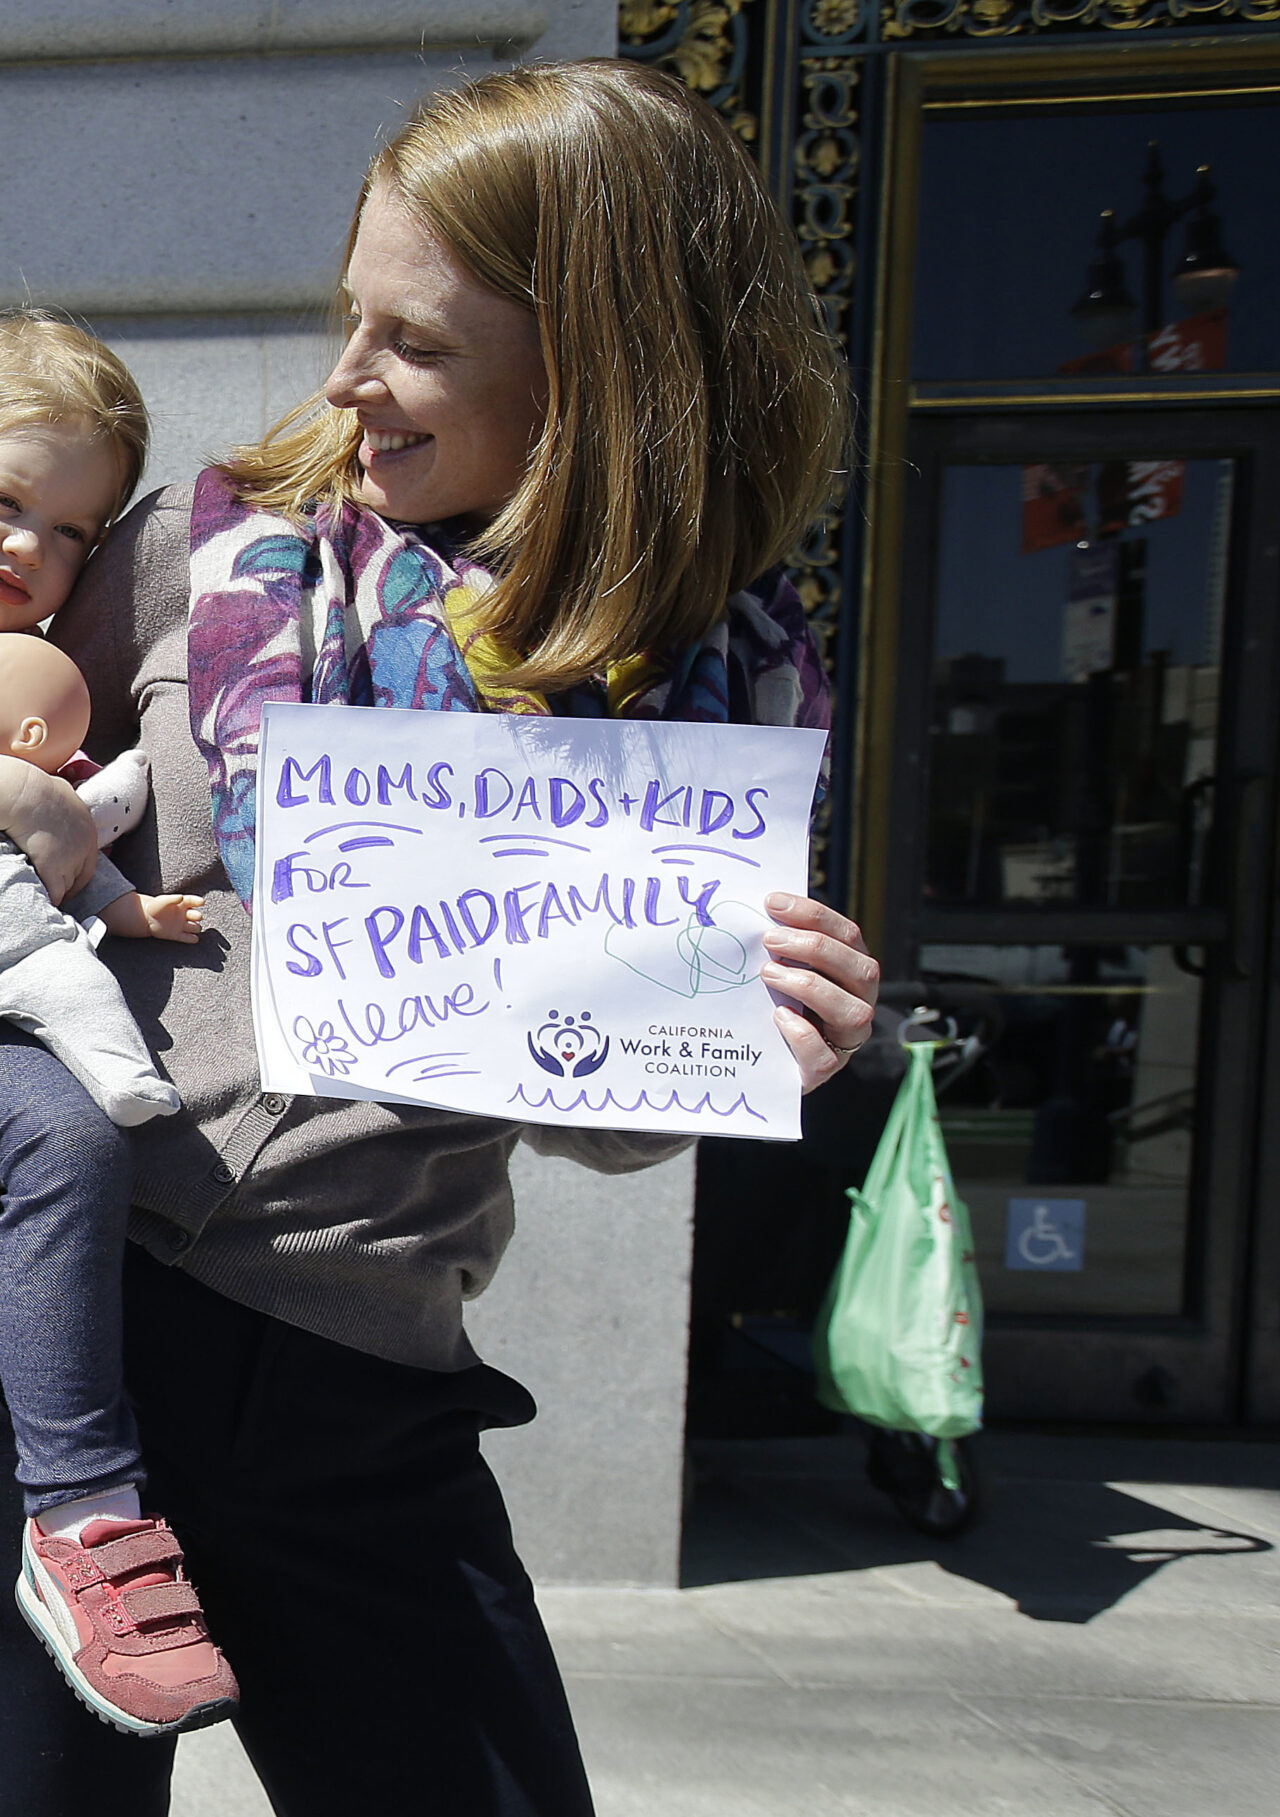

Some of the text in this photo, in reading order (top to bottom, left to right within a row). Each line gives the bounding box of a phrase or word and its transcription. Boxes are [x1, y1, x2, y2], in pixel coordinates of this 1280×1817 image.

[474, 767, 610, 829] DADS
[640, 779, 770, 840] KIDS
[271, 851, 371, 904] FOR
[286, 873, 722, 980] SF PAID FAMILY
[619, 1038, 763, 1067] Work & Family
[648, 1024, 734, 1040] CALIFORNIA
[644, 1061, 736, 1079] COALITION
